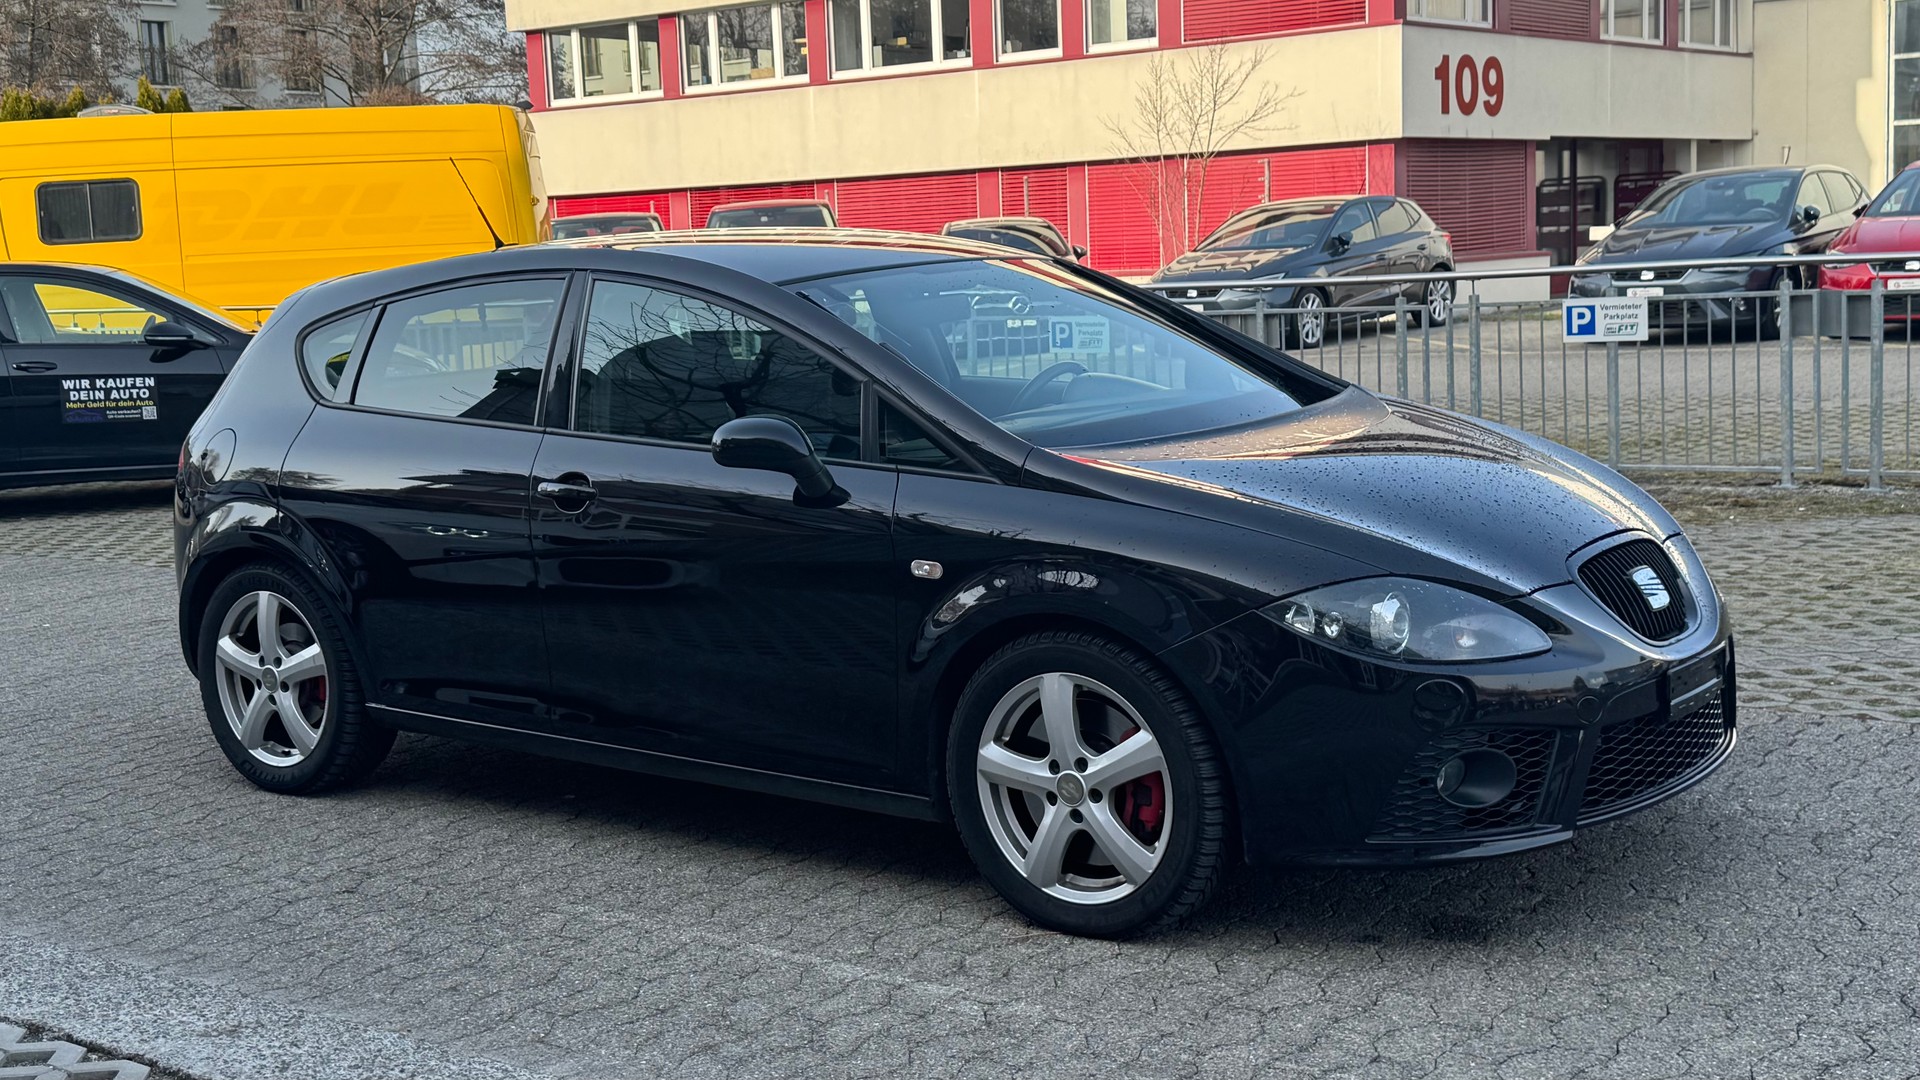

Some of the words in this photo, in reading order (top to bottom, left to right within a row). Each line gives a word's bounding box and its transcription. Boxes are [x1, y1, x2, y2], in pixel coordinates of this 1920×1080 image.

[1434, 54, 1504, 117] 109
[1600, 303, 1642, 311] Vermieteter
[1571, 307, 1592, 334] P
[1604, 313, 1639, 321] Parkplatz
[1617, 323, 1636, 334] FIT
[1055, 323, 1070, 347] P
[62, 379, 91, 389] WIR
[96, 377, 155, 389] KAUFEN
[69, 390, 105, 401] DEIN
[110, 389, 150, 399] AUTO
[118, 399, 135, 407] dein
